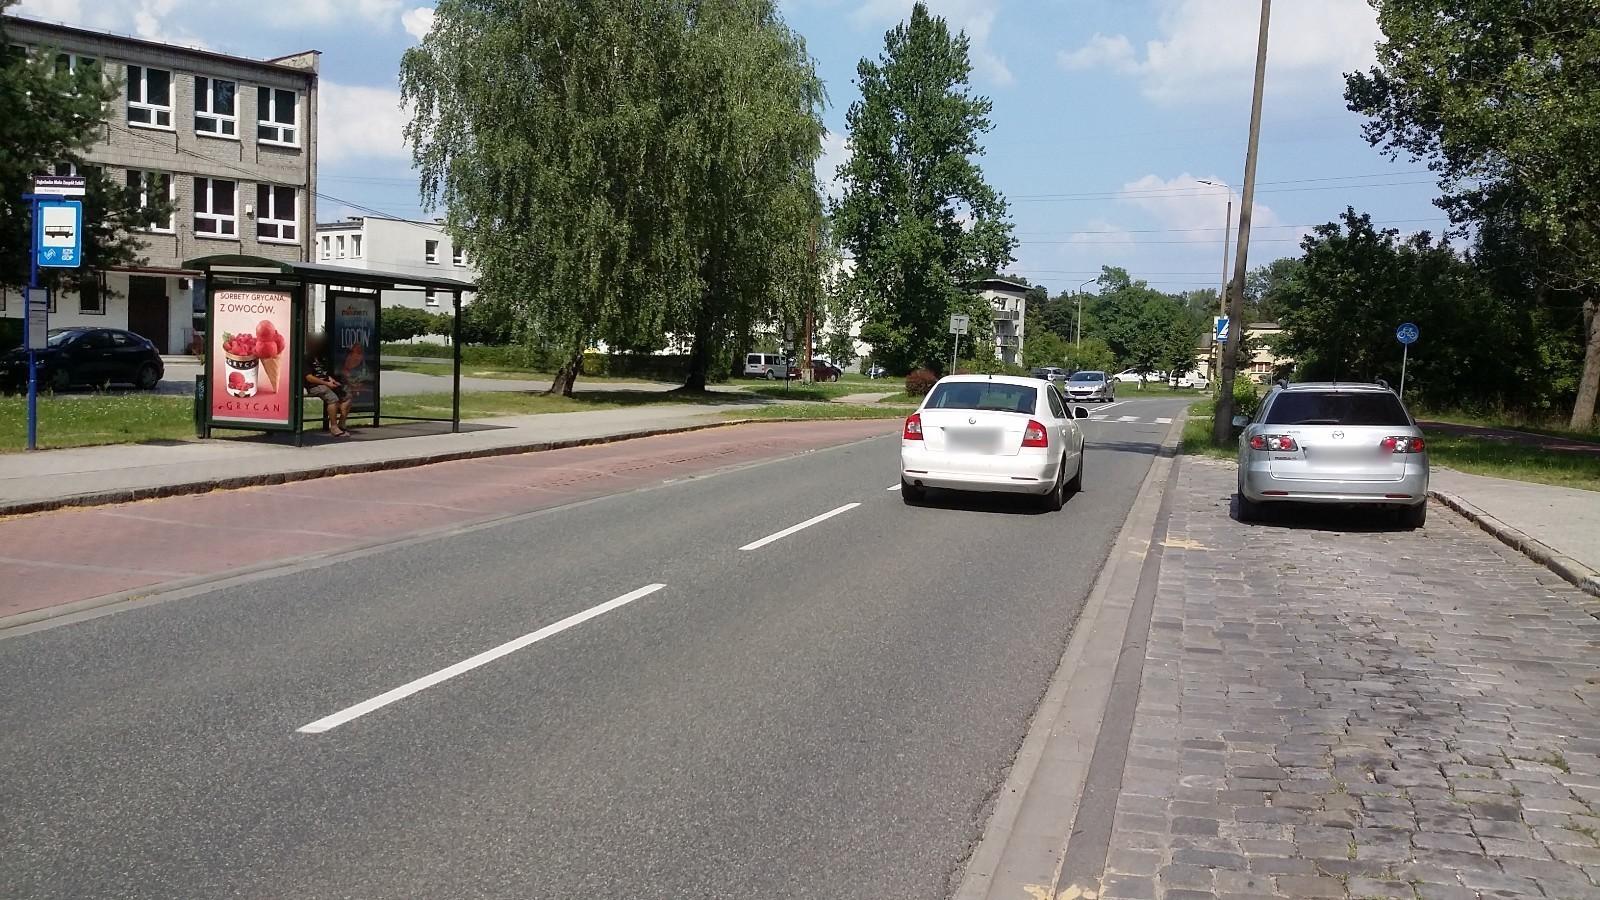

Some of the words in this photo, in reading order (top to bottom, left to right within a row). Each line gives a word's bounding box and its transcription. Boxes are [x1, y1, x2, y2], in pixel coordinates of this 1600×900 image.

[220, 304, 224, 312] Z
[228, 303, 275, 314] OWOCÓW.
[226, 402, 280, 412] GRYCAN
